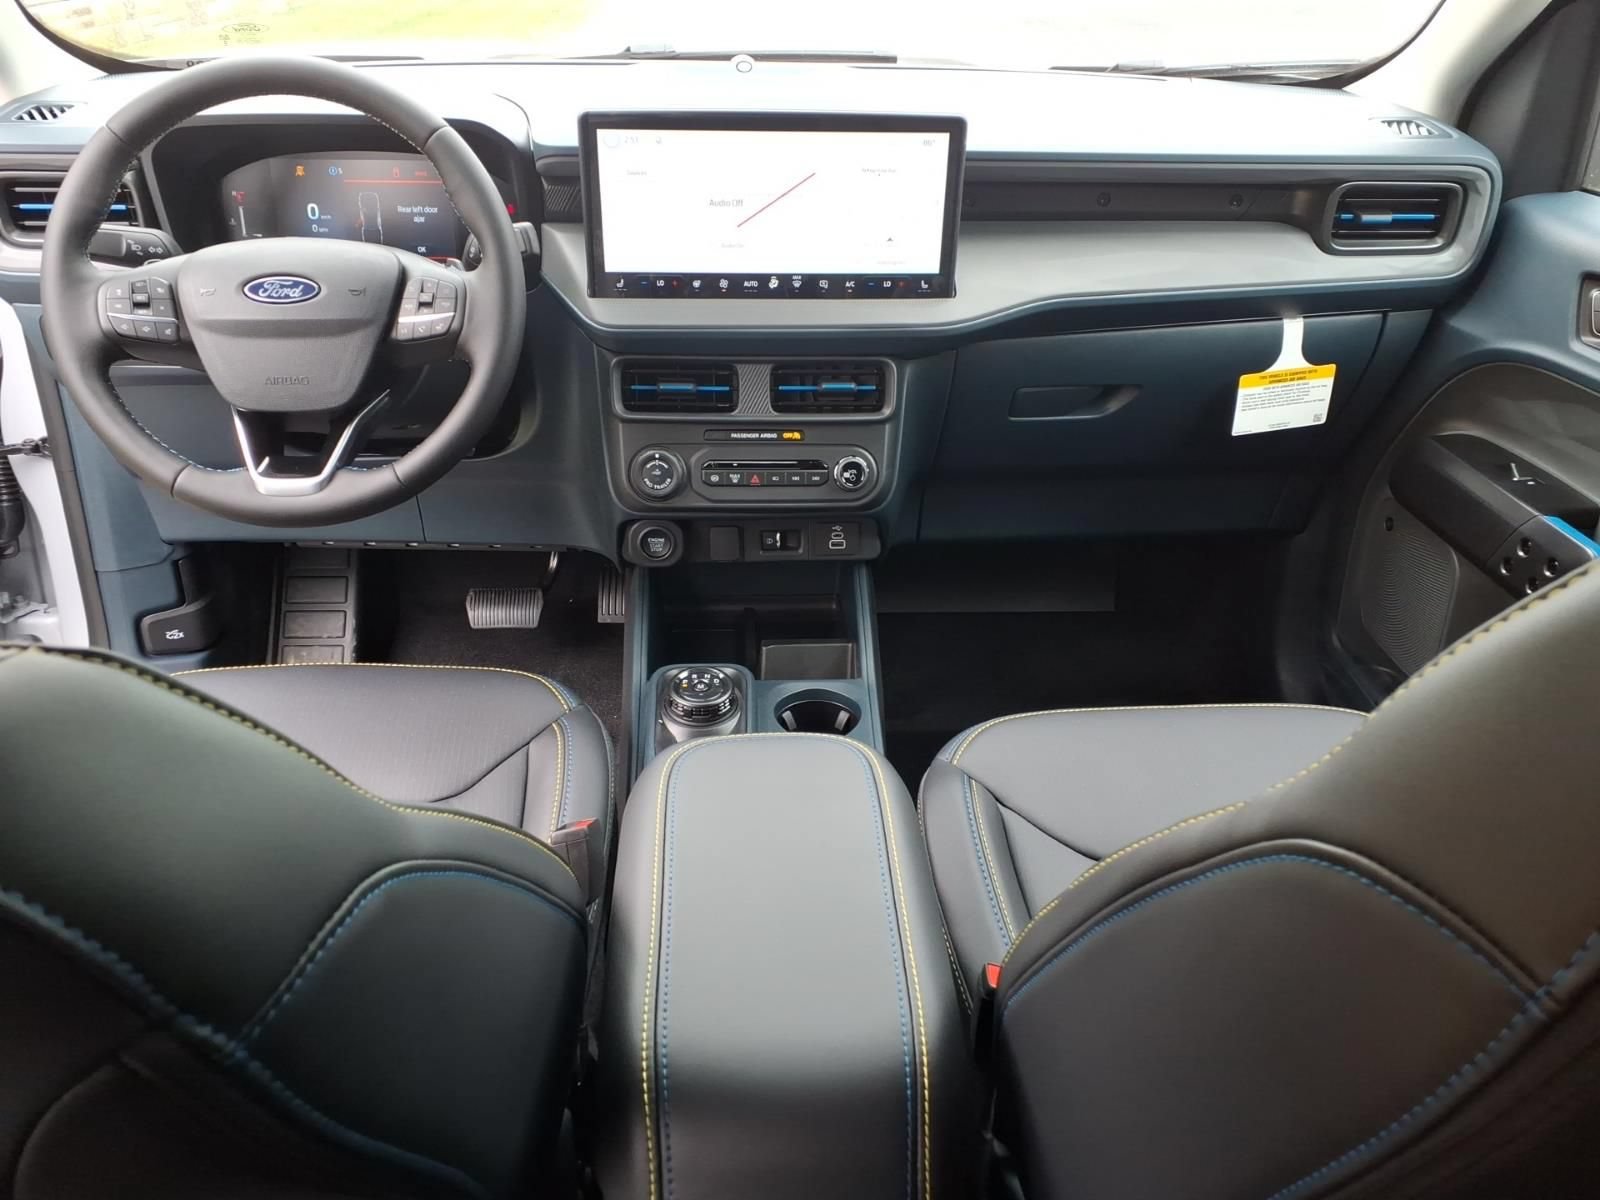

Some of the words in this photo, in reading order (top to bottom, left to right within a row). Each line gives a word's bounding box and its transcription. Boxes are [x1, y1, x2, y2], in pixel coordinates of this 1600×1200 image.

[709, 199, 731, 207] Audio
[307, 203, 319, 219] 0
[397, 205, 411, 213] Rear
[412, 205, 423, 213] left
[424, 205, 438, 213] door
[258, 280, 304, 297] Ford
[265, 376, 310, 386] AIRBAG
[644, 478, 653, 487] PRO
